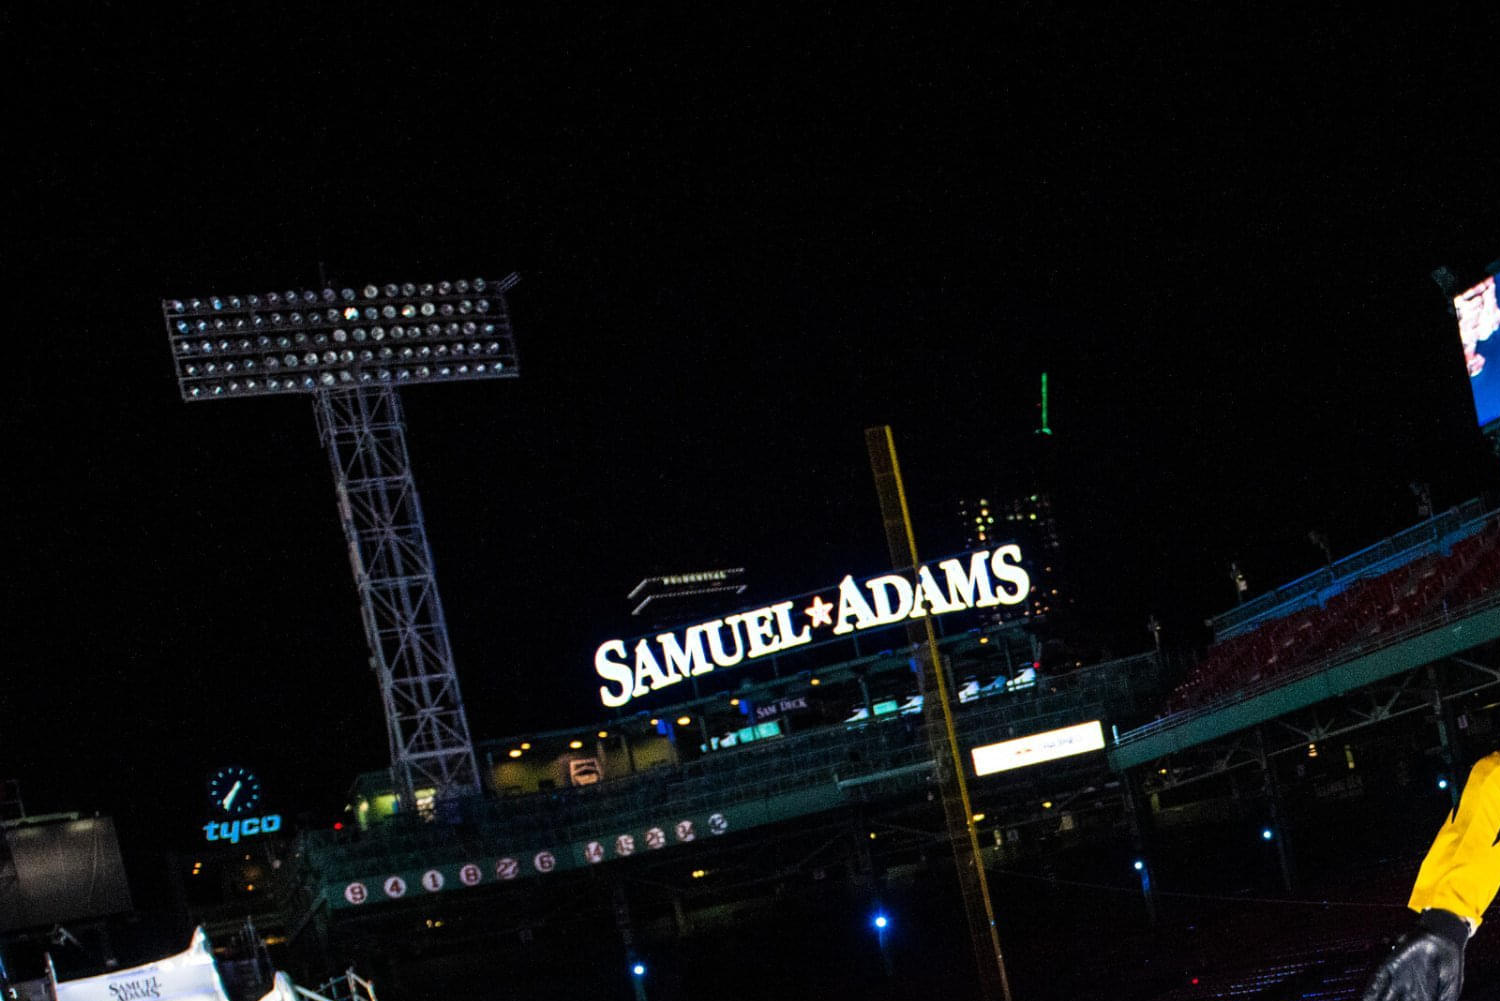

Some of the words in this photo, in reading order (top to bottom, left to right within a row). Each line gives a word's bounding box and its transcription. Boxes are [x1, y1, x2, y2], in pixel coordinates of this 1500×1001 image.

[595, 600, 811, 708] SAMUEL
[832, 543, 1031, 635] ADAMS
[203, 814, 283, 844] tyco
[108, 974, 163, 998] SAMUEL
